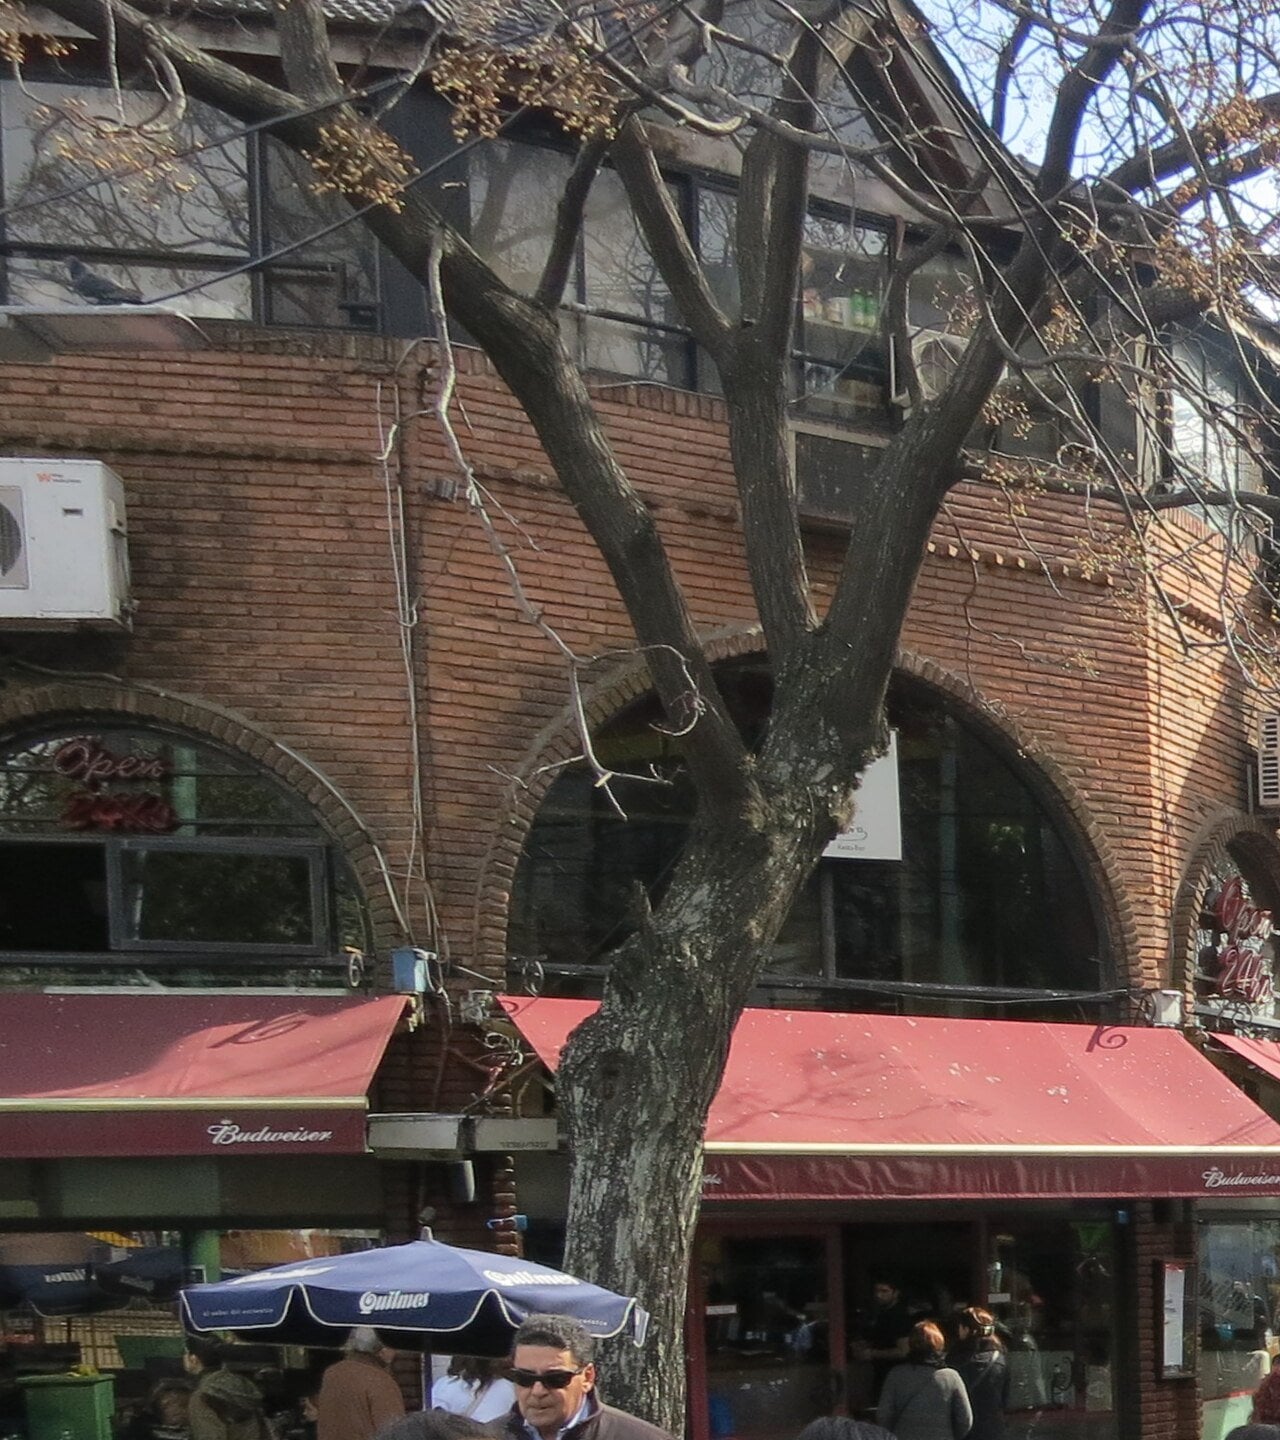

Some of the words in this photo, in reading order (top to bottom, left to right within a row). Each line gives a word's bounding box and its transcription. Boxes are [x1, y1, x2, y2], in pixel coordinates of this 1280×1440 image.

[54, 743, 165, 782] Open
[207, 1124, 332, 1145] Budweiser
[359, 1290, 430, 1315] Quilmes
